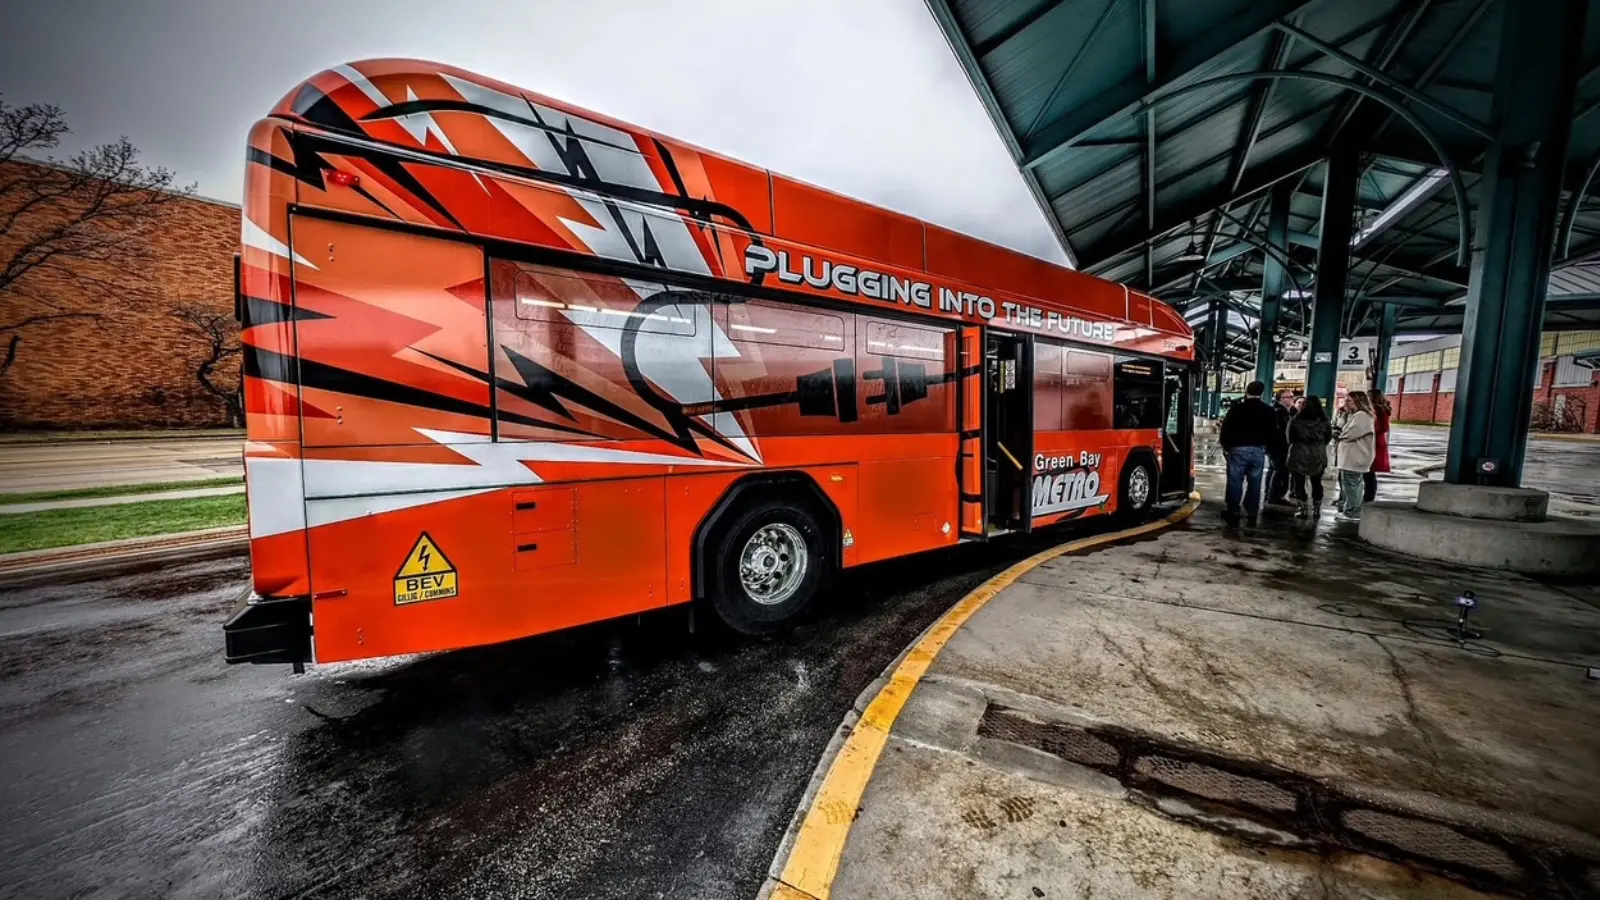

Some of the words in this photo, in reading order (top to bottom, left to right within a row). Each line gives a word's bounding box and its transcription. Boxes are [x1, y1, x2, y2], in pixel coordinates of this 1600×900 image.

[745, 244, 931, 308] PLUGGING
[939, 288, 995, 319] INTO
[1002, 301, 1042, 328] THE
[1047, 312, 1113, 341] FUTURE
[1348, 346, 1359, 359] 3
[1035, 453, 1074, 470] Green
[1080, 450, 1101, 468] Bay
[1032, 471, 1100, 508] METRO
[406, 574, 445, 592] BEV
[425, 586, 455, 598] CUMMINS
